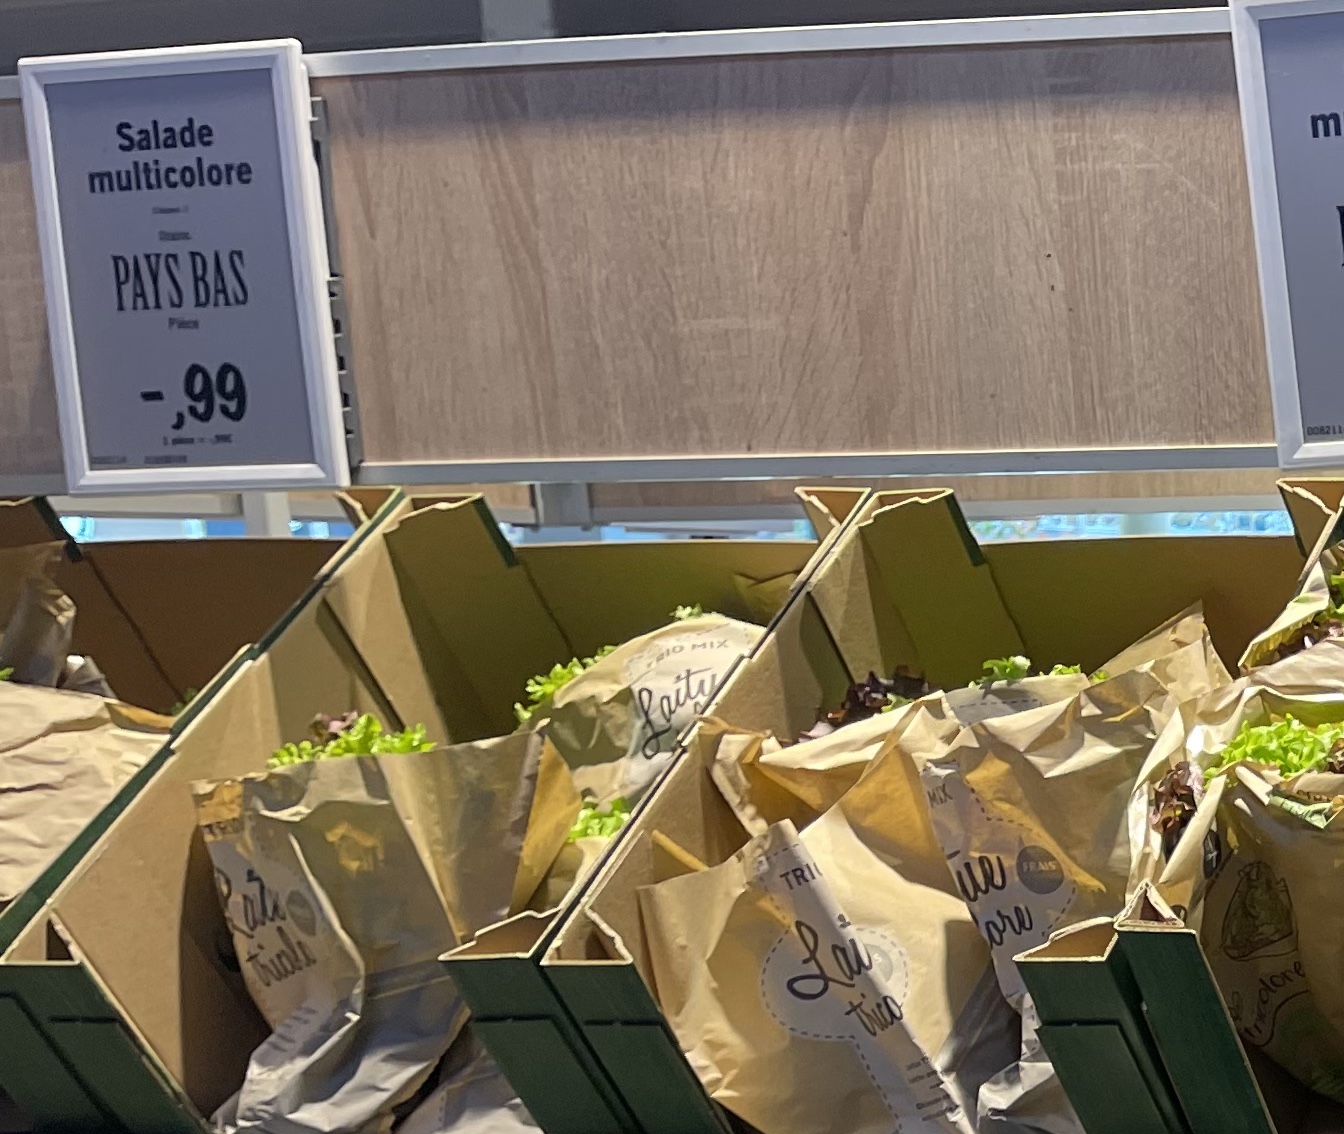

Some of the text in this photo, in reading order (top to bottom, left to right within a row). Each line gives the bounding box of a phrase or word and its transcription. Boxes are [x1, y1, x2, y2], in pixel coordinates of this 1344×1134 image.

[116, 118, 214, 153] Salade
[88, 157, 253, 194] multicolore
[111, 249, 249, 312] PAYS BAS
[140, 362, 248, 430] -,99
